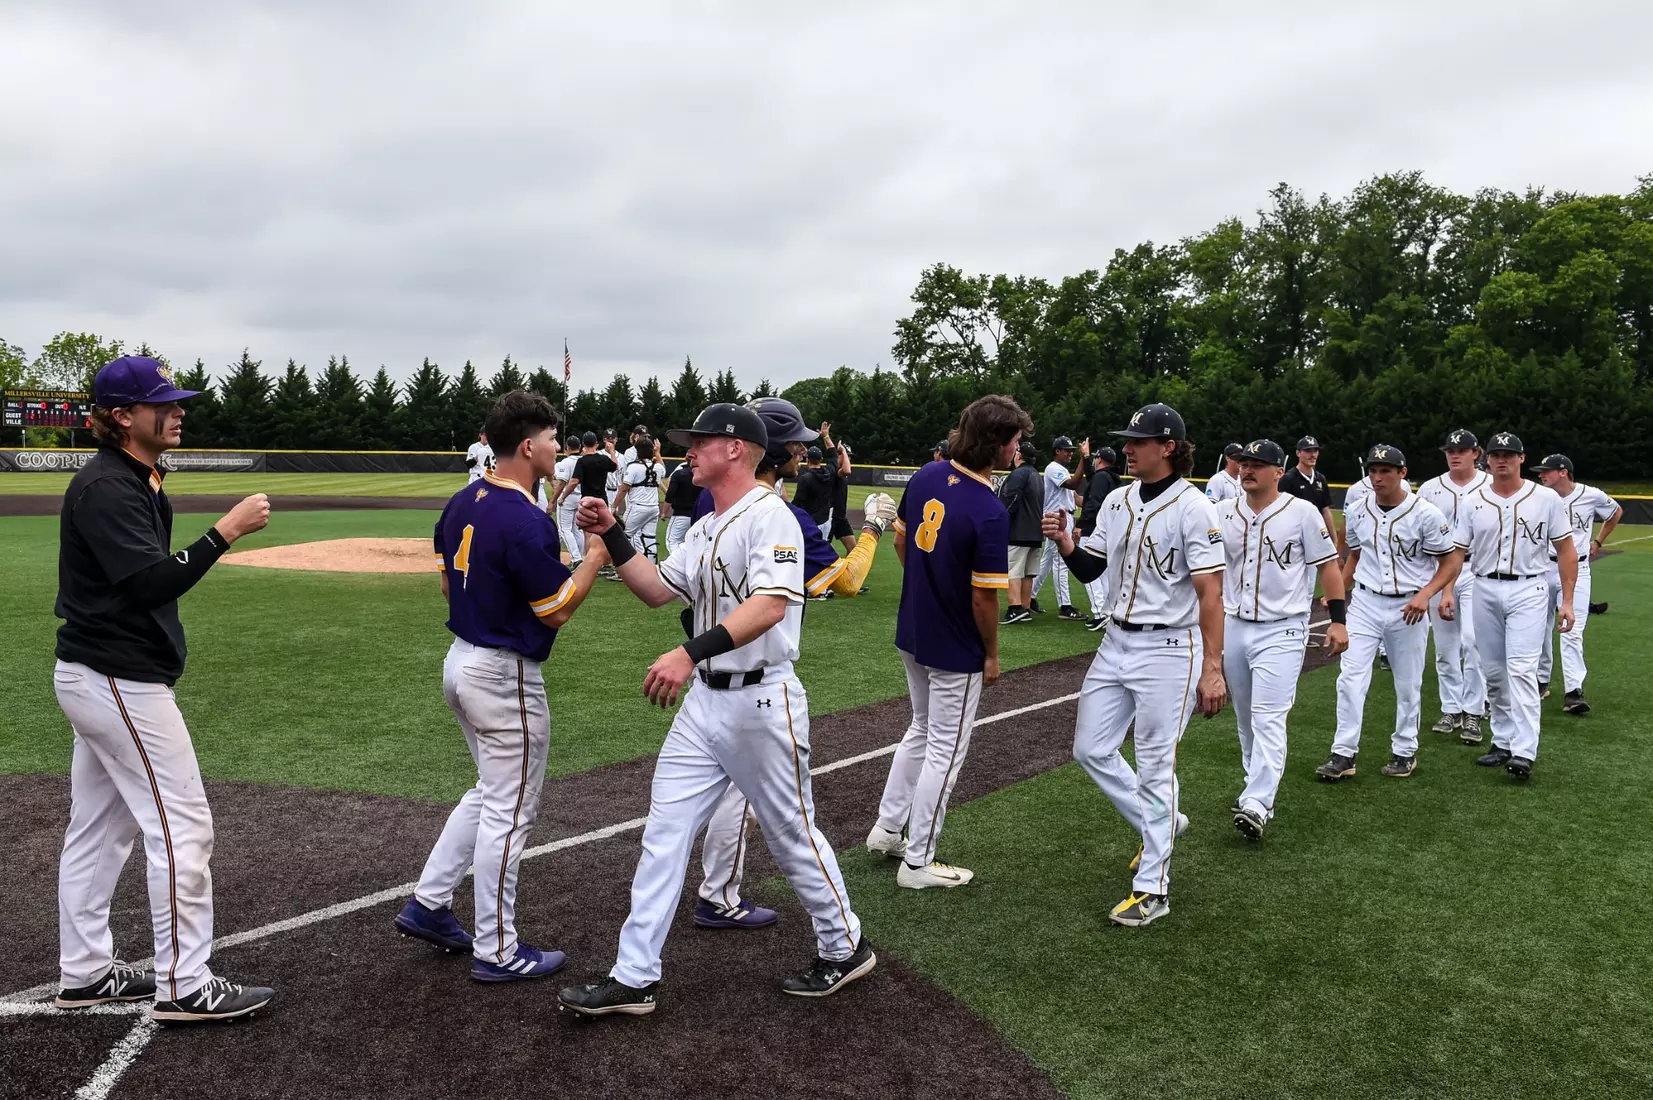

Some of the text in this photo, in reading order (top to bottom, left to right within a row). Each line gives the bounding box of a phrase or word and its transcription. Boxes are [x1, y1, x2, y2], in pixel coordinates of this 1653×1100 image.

[15, 452, 98, 469] COOPE
[915, 498, 945, 553] 8
[453, 524, 475, 589] 4
